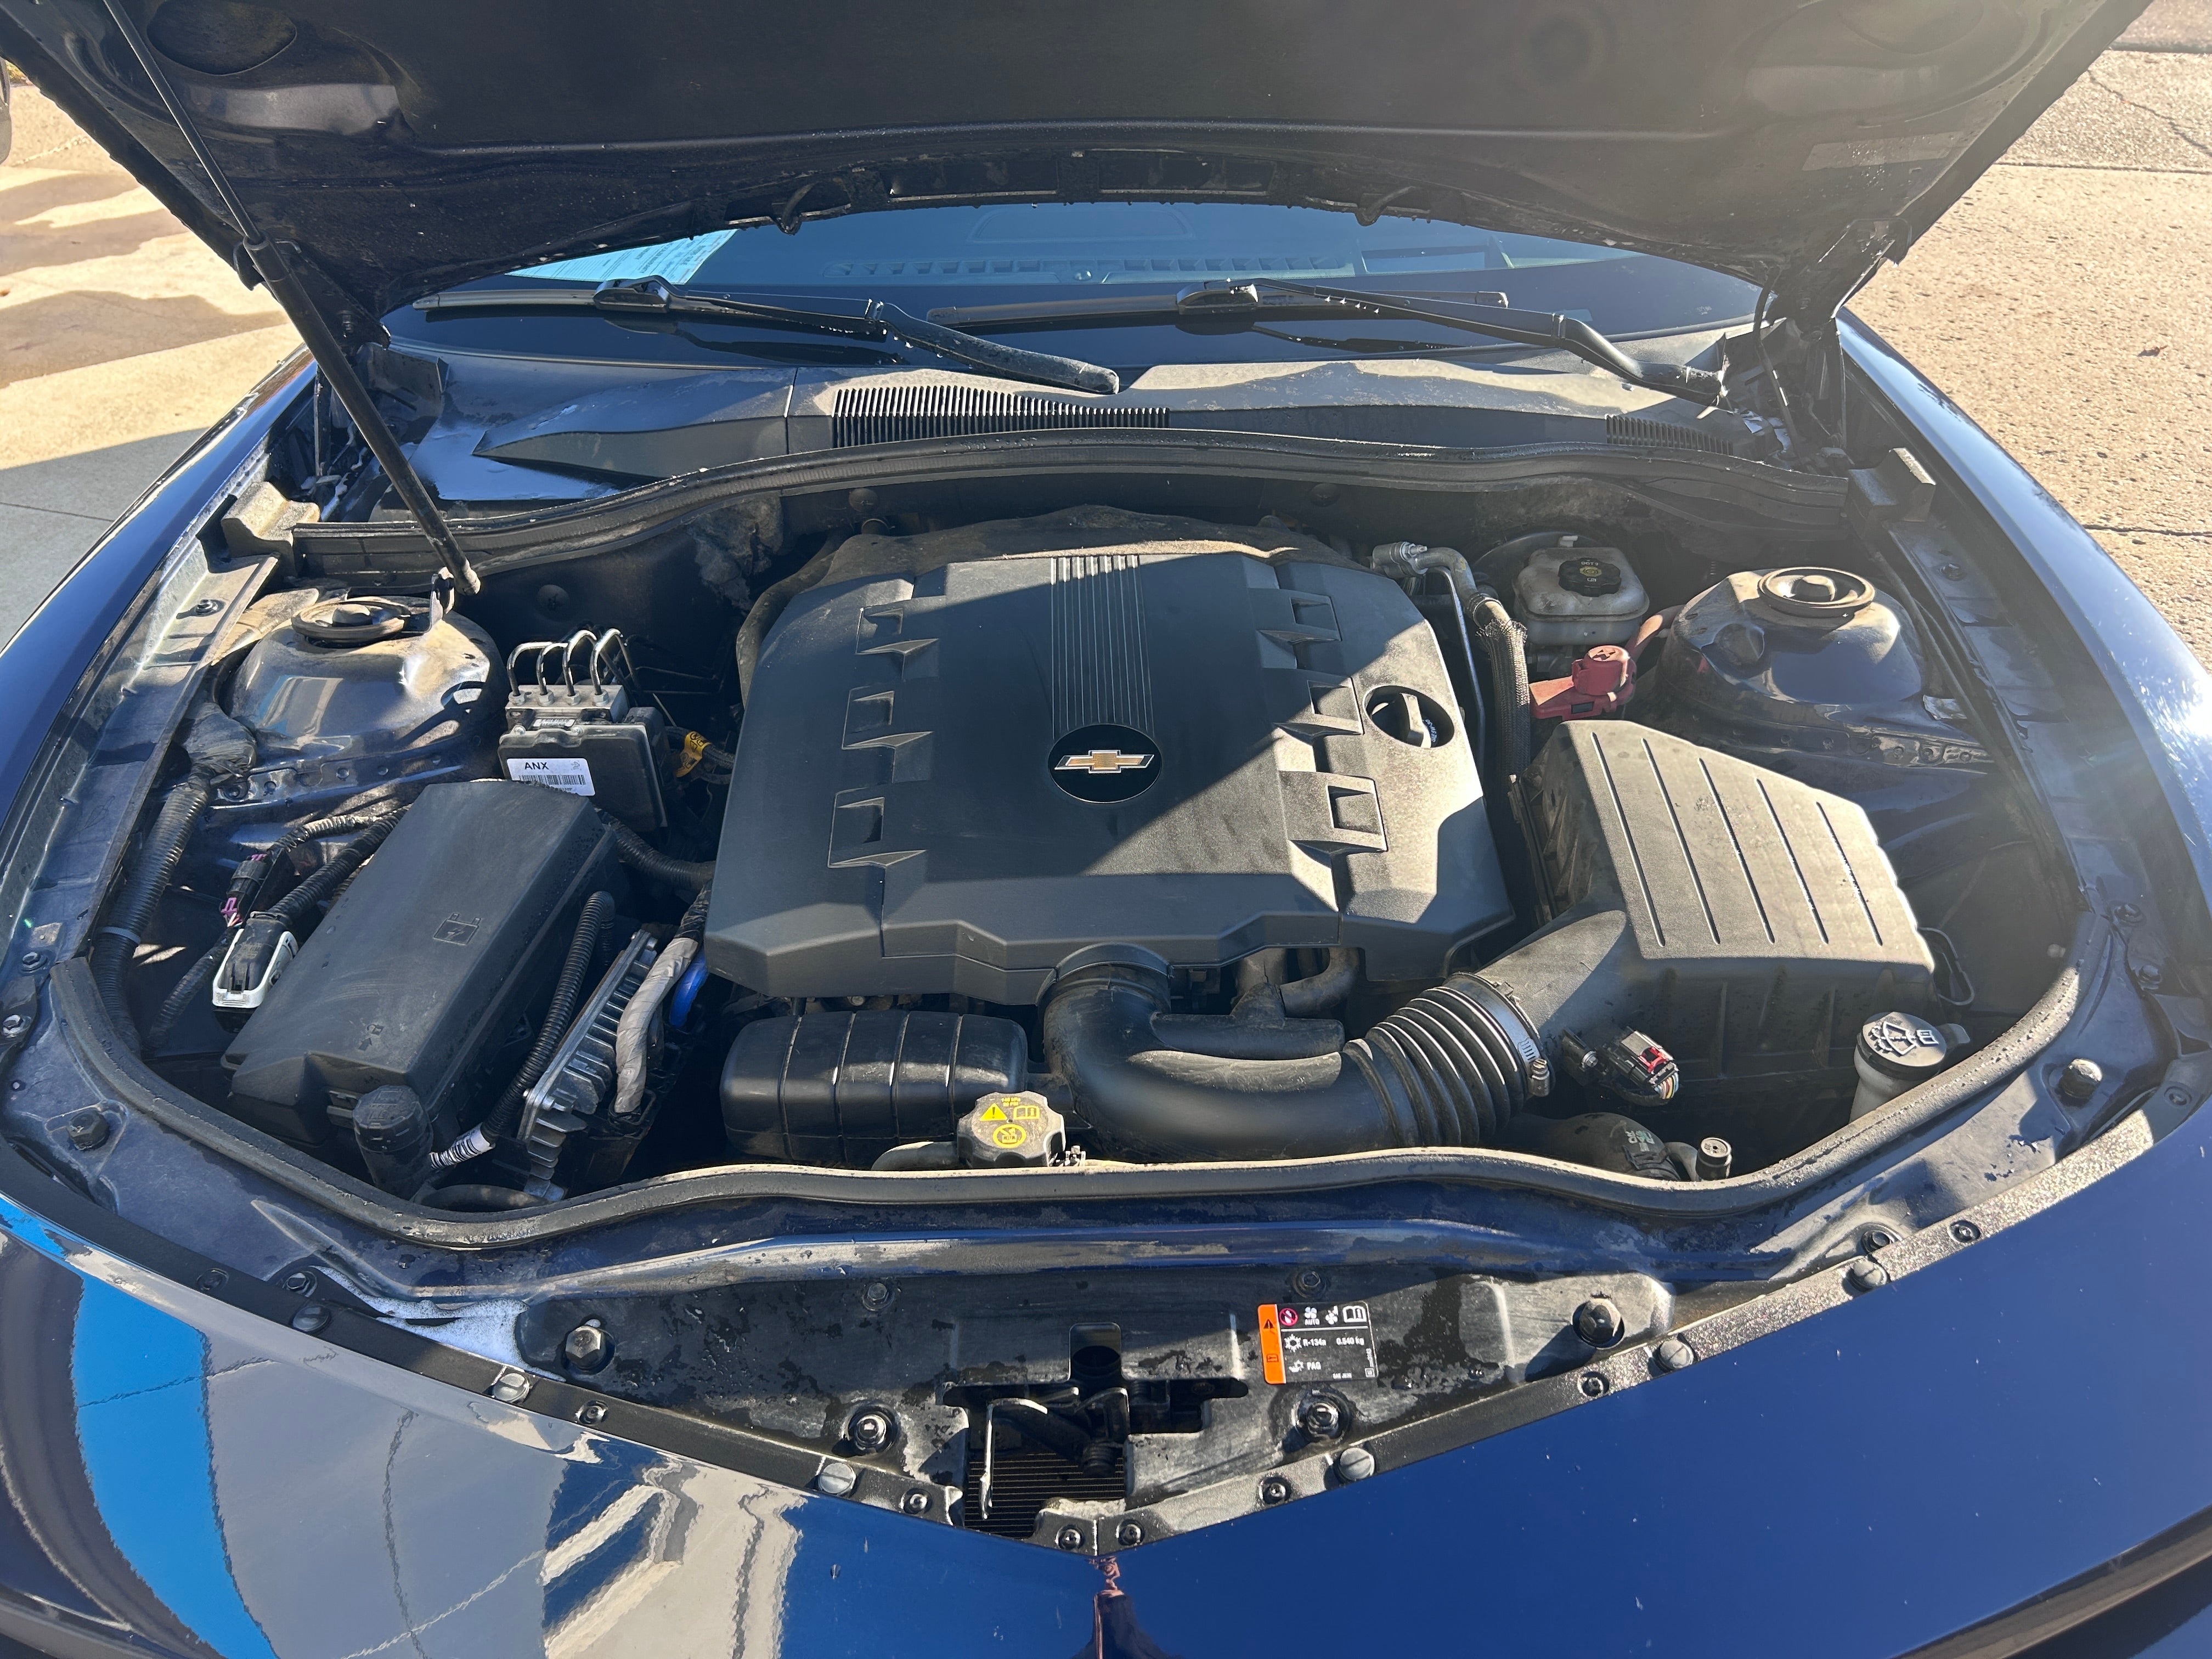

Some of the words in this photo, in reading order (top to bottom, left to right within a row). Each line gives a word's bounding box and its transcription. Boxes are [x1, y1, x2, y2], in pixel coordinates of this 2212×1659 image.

[1303, 1339, 1327, 1347] R-134a
[1355, 1336, 1365, 1346] kg
[1307, 1362, 1322, 1370] PAG
